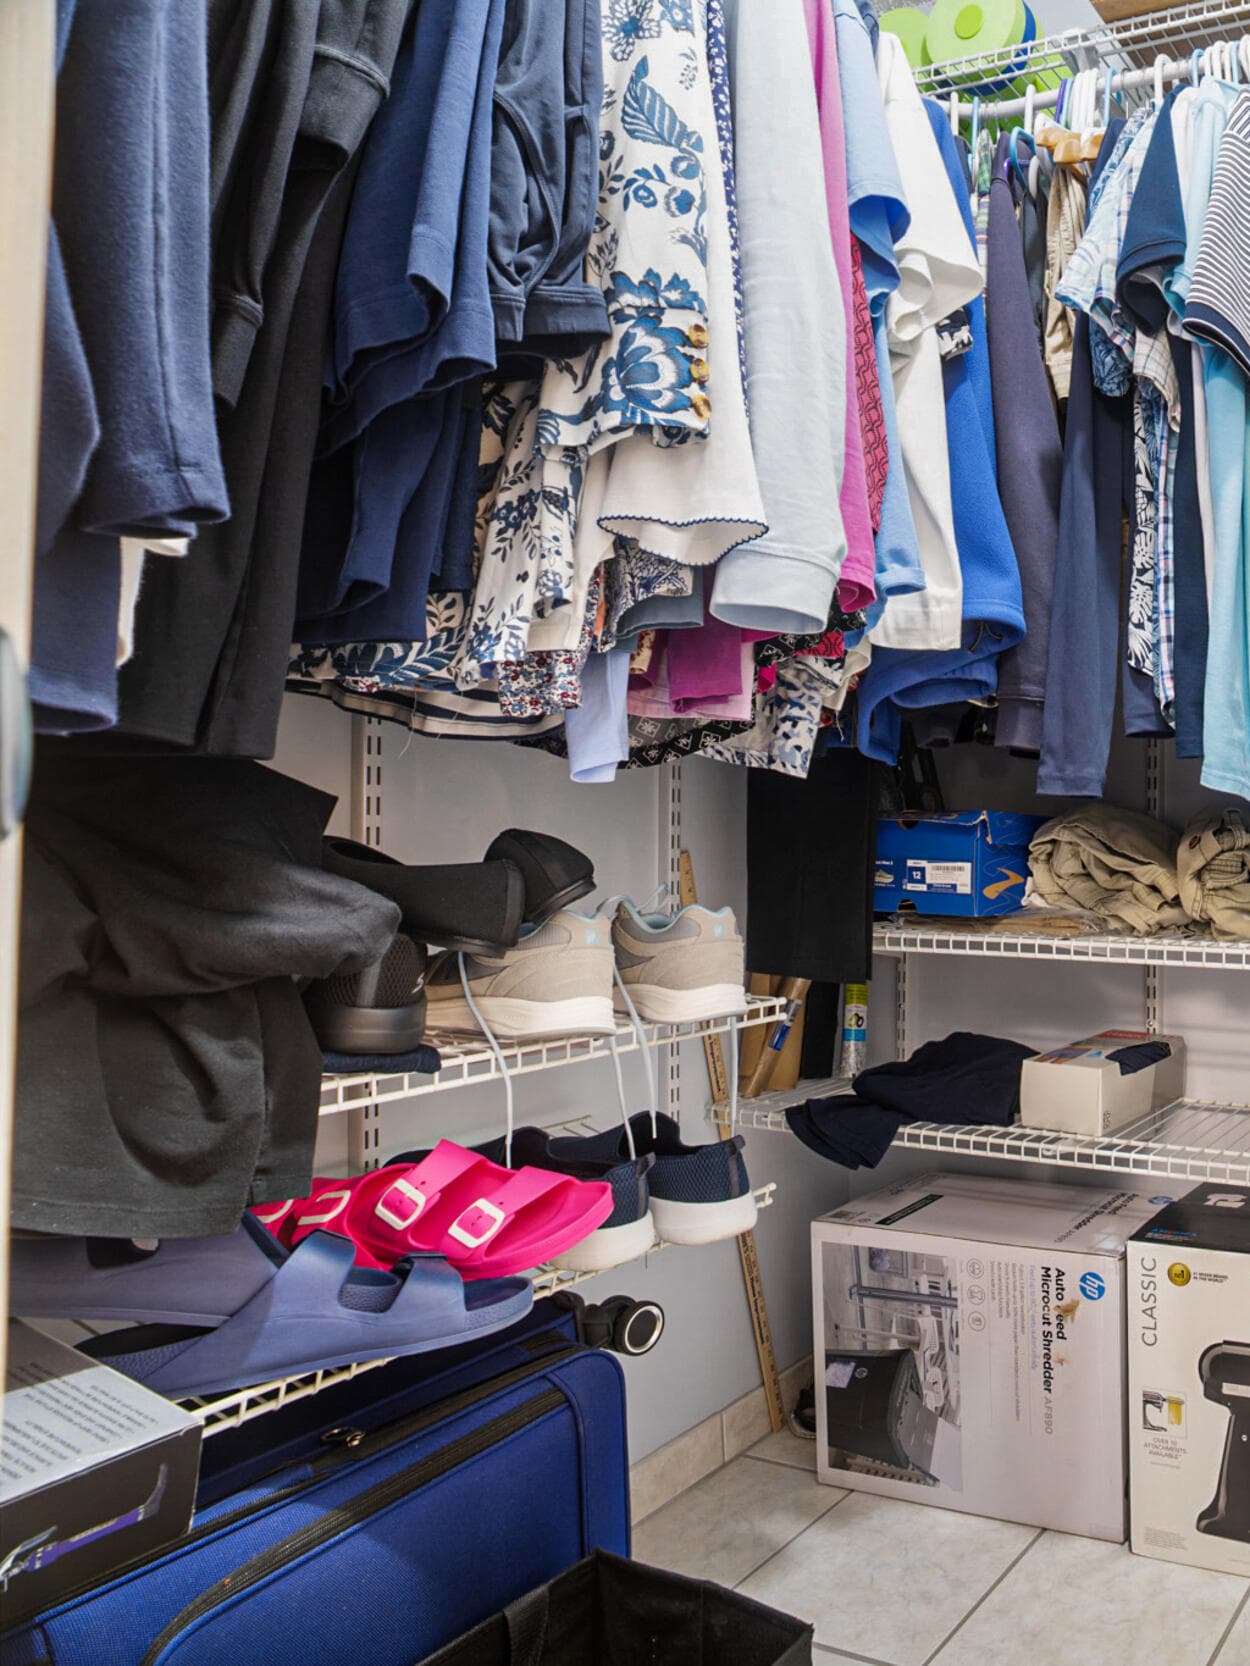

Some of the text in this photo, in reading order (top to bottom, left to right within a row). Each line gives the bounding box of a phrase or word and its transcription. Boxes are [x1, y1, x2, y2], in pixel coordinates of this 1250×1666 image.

[1041, 1266, 1052, 1327] Microcut
[1055, 1268, 1067, 1341] Auto eed
[1140, 1257, 1157, 1347] CLASSIC
[1042, 1330, 1054, 1393] Shredder
